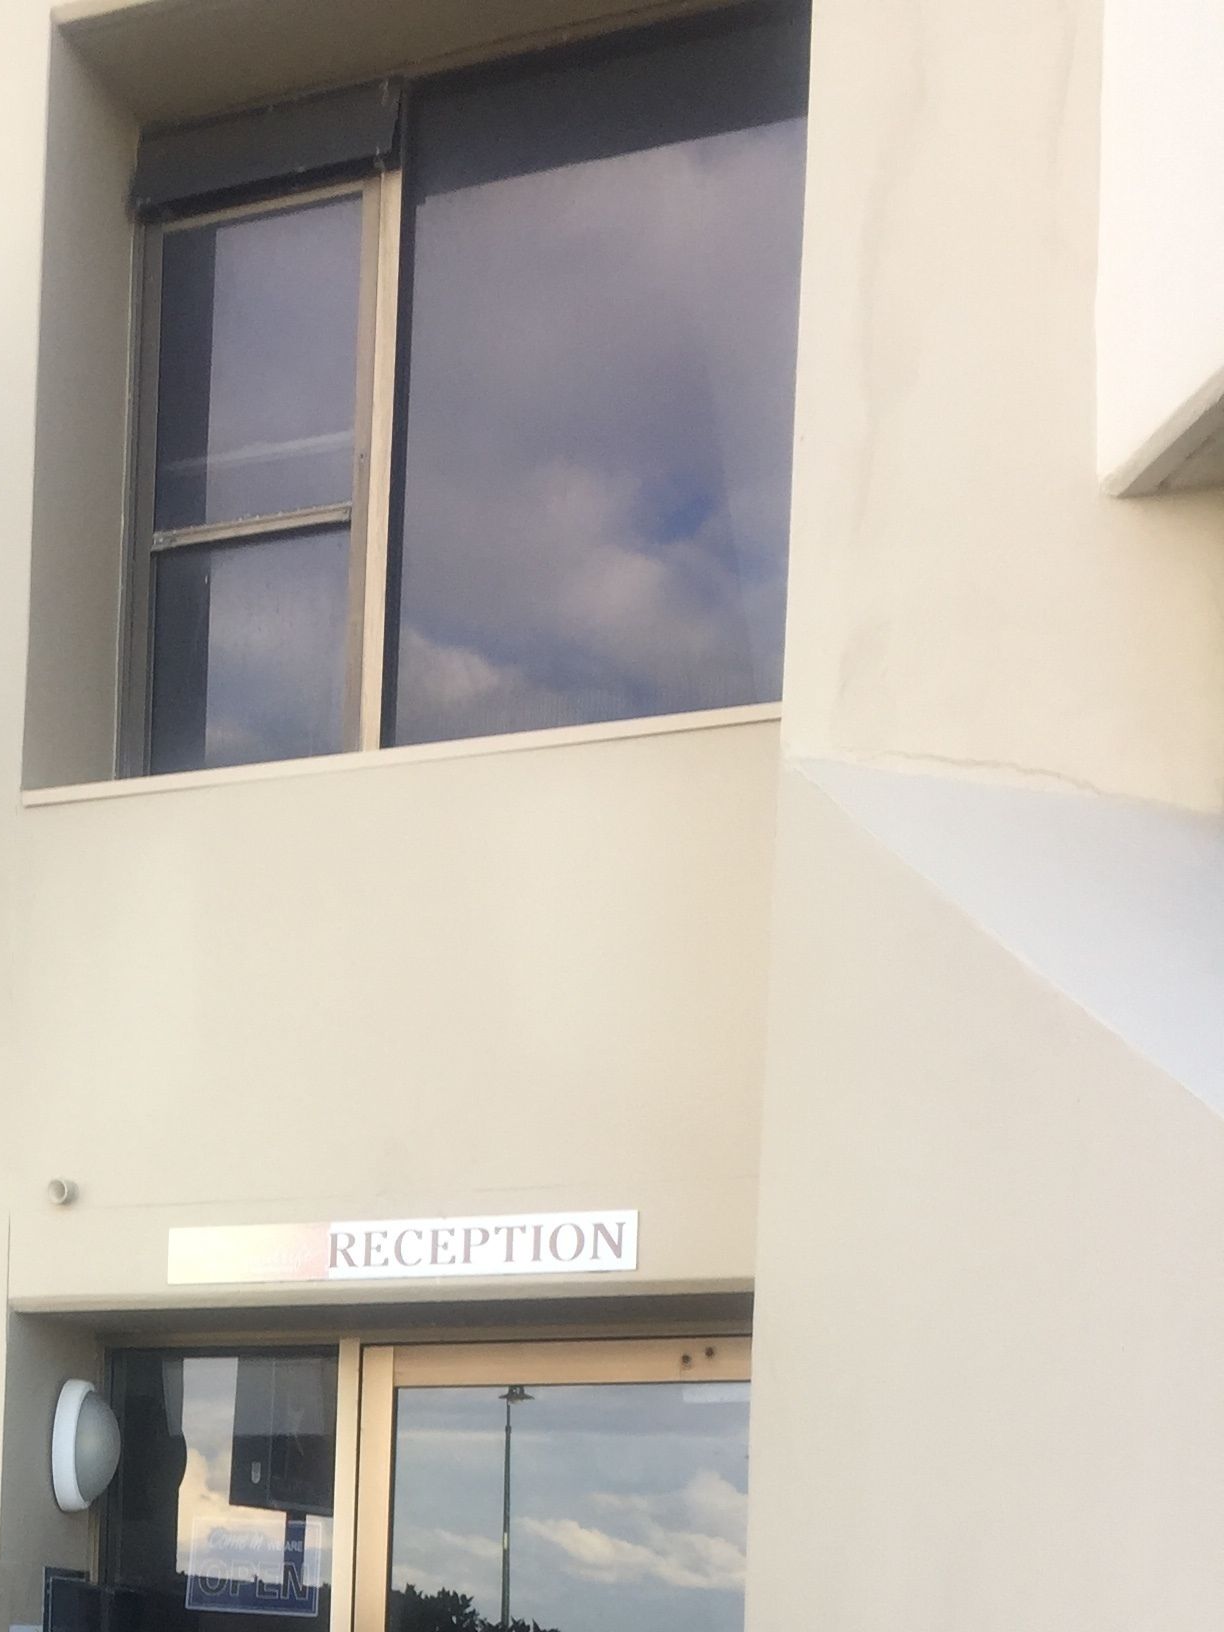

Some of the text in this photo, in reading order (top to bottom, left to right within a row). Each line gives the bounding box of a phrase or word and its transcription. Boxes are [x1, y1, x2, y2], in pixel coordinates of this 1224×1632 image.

[328, 1220, 626, 1269] RECEPTION
[284, 1540, 303, 1552] ARE
[198, 1559, 310, 1601] OPEN
